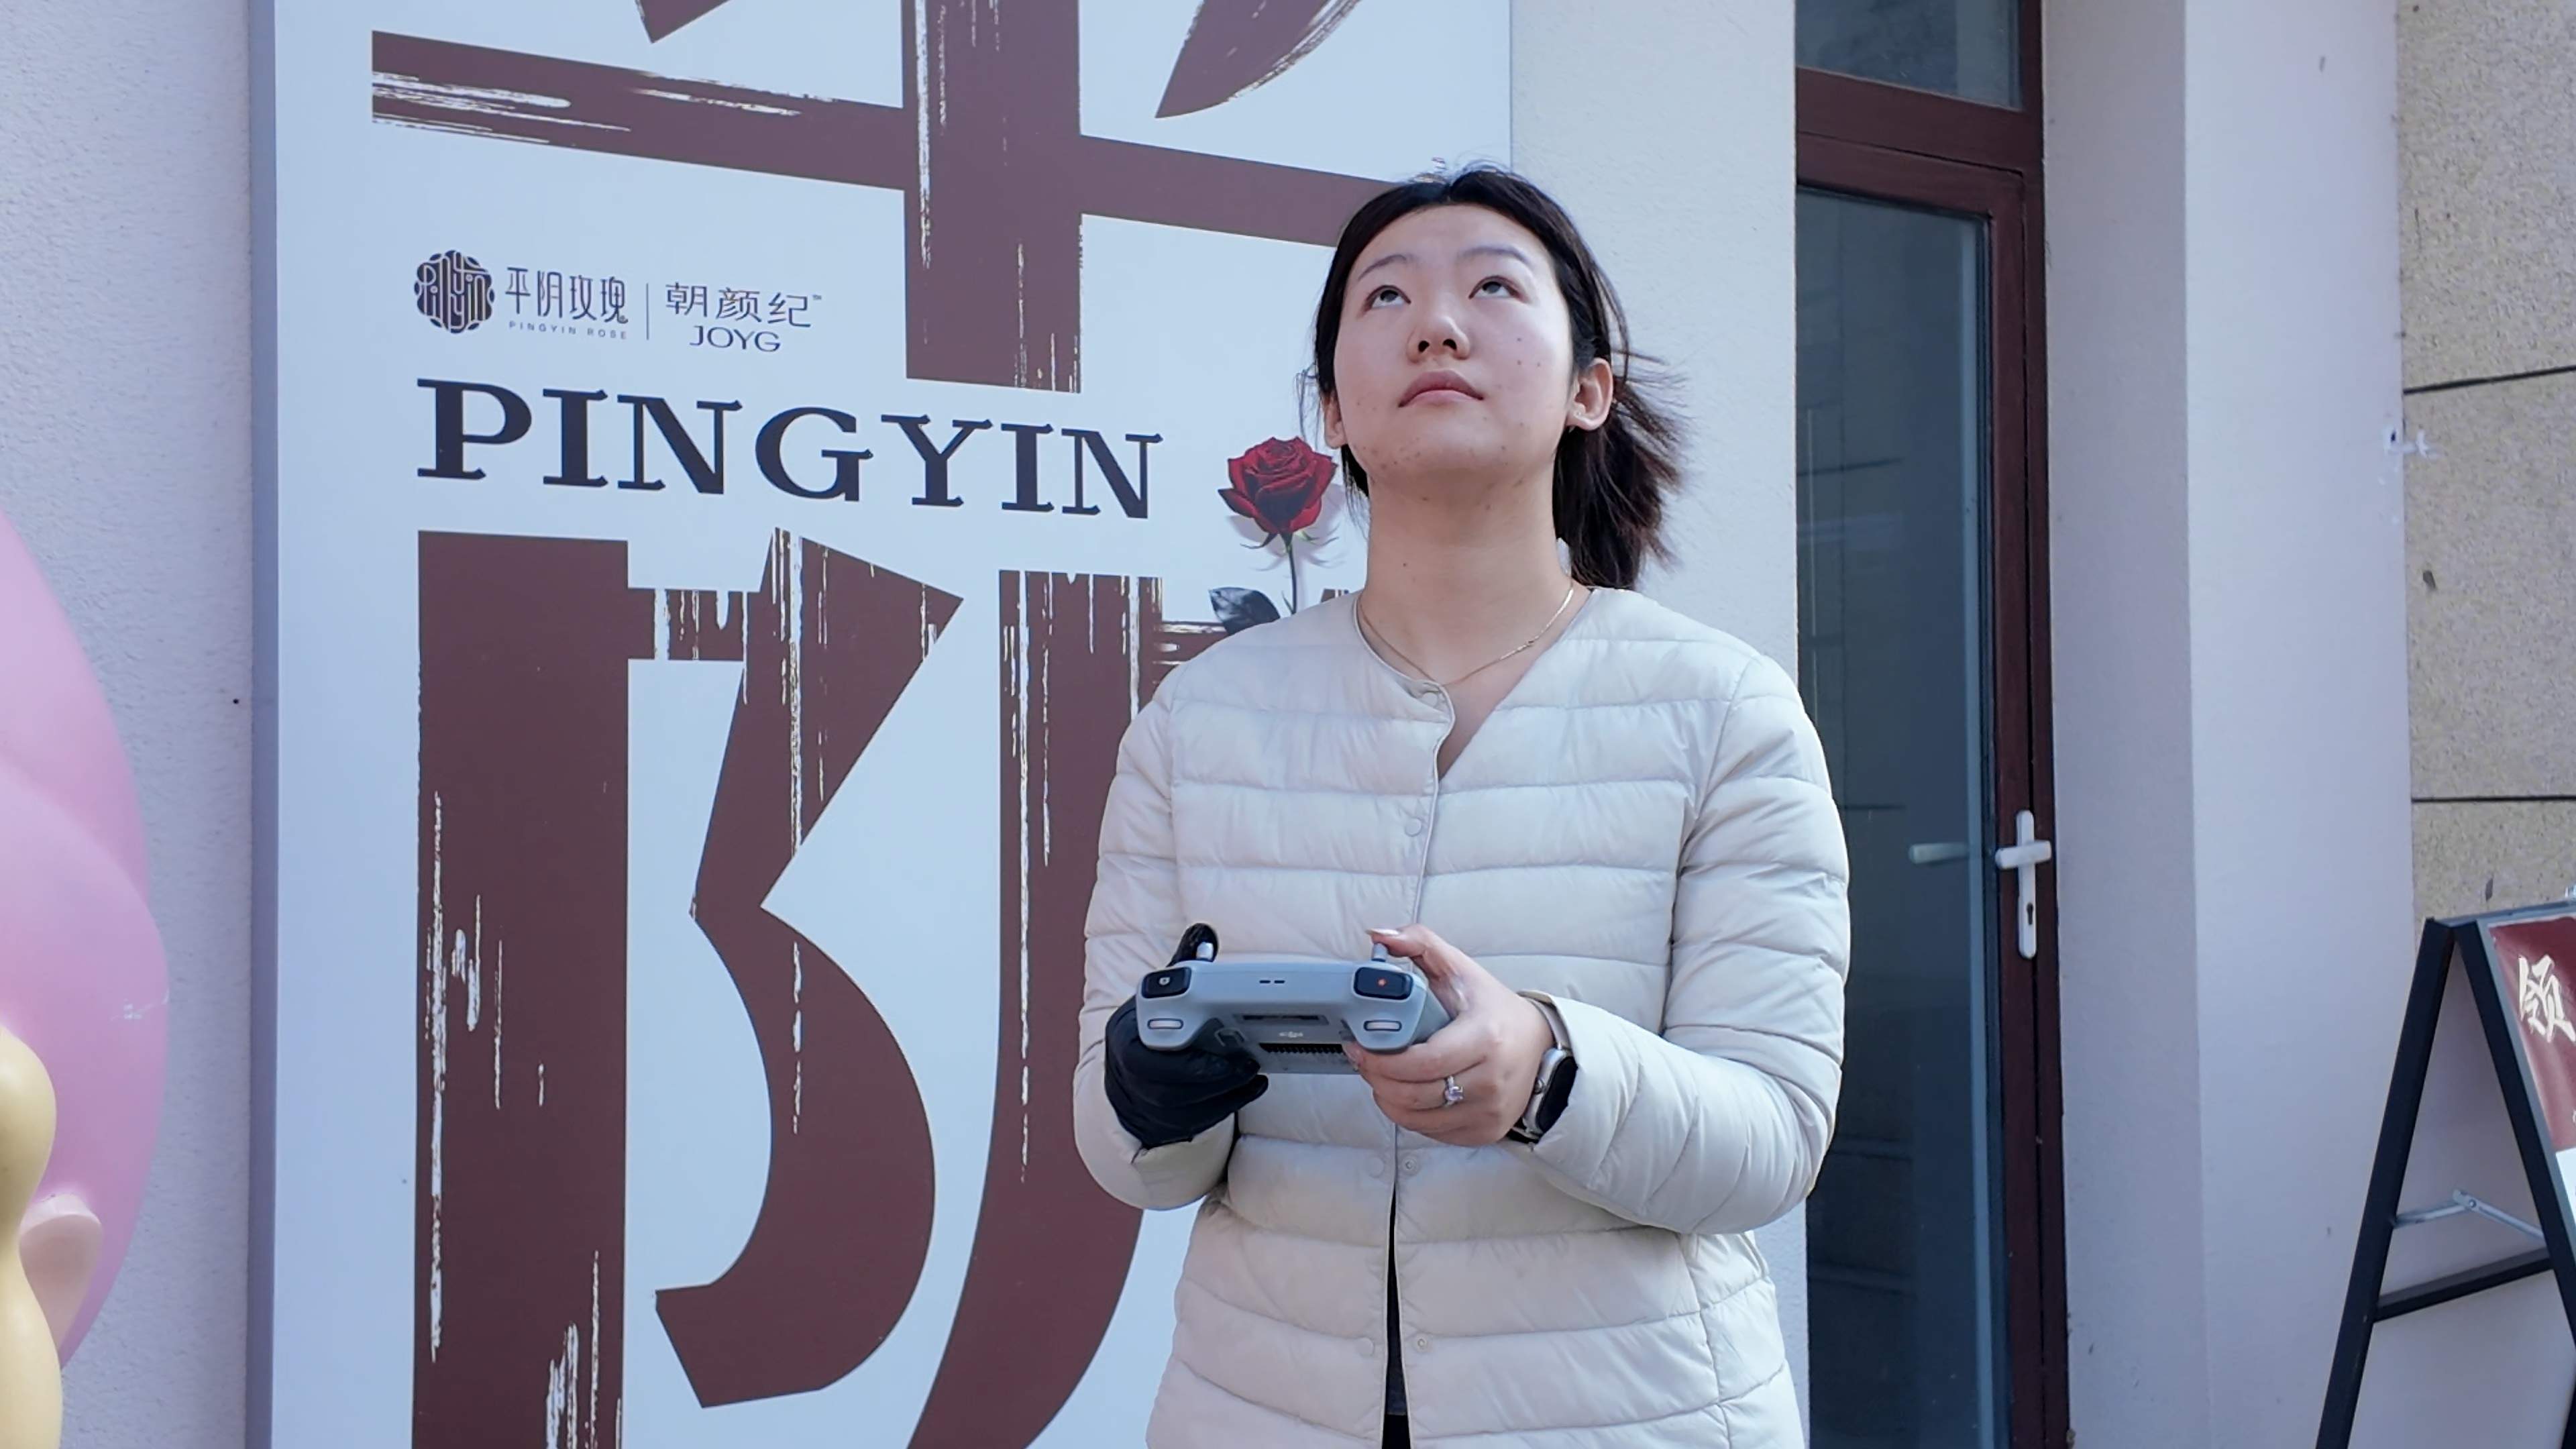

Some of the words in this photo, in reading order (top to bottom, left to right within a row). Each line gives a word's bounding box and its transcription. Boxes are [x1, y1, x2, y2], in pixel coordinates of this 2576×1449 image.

[505, 266, 629, 324] 平阴玫瑰
[665, 282, 811, 327] 朝颜纪
[508, 321, 576, 335] PINGYIN
[587, 327, 627, 340] ROSE
[689, 325, 782, 352] JOYG
[417, 378, 1163, 519] PINGYIN
